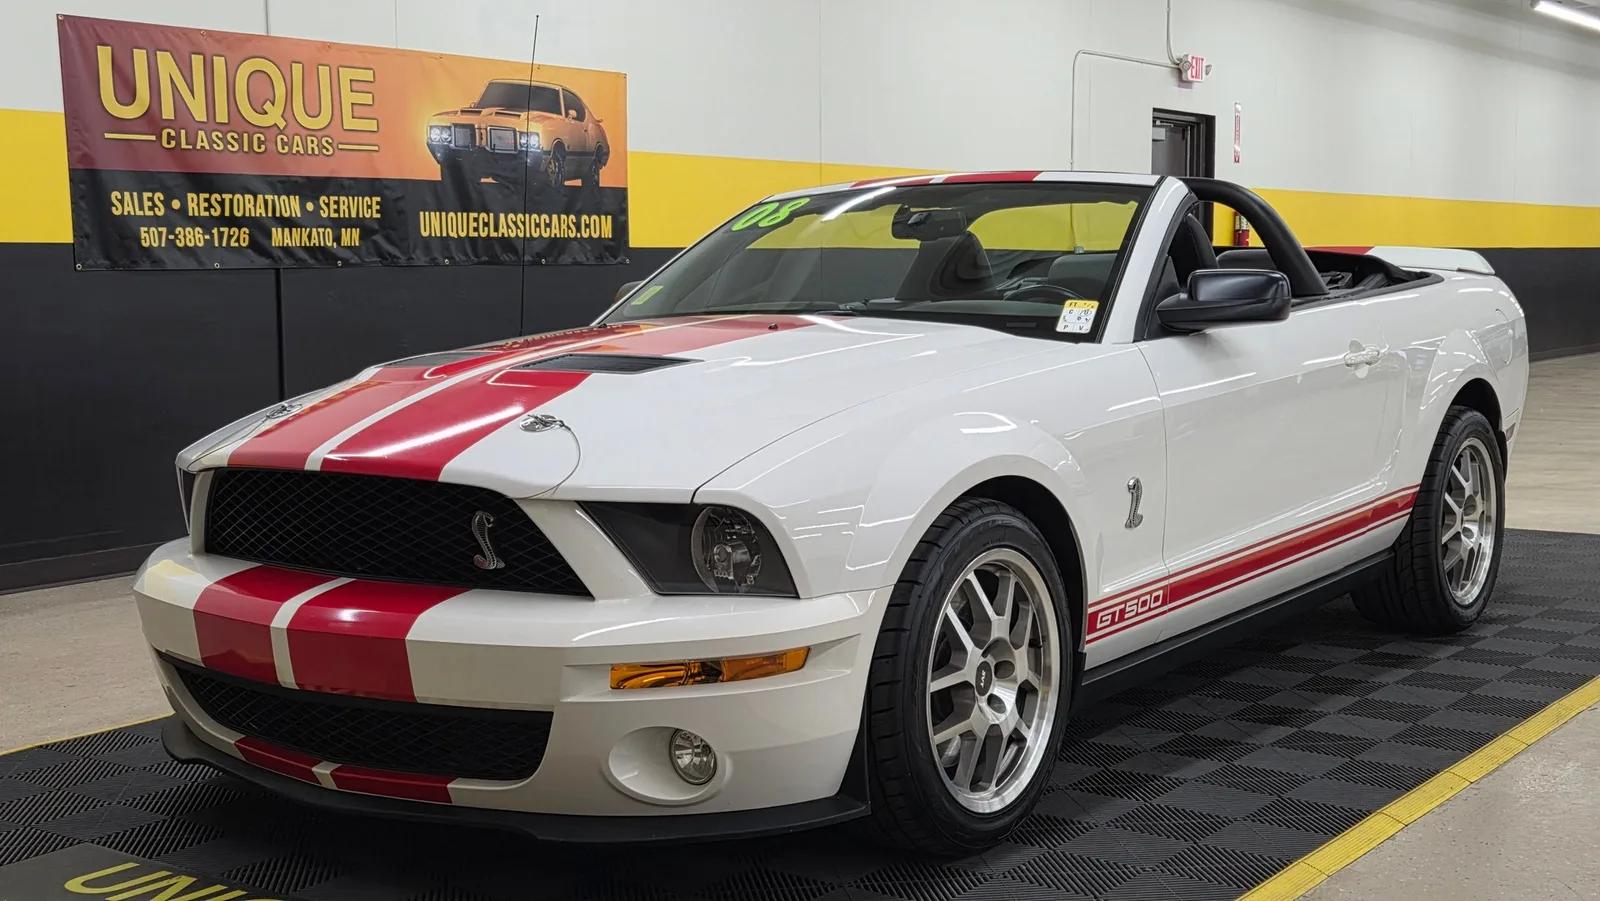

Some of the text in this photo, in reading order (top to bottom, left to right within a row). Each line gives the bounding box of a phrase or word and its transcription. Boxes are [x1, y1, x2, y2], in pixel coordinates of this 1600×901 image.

[97, 45, 378, 130] UNIQUE
[162, 128, 335, 156] CLASSIC CARS
[110, 191, 381, 219] SALES RESTORATION SERVICE
[731, 197, 811, 231] 08
[139, 227, 360, 249] 507-386-1726 MANKATO, MN
[420, 211, 612, 239] UNIQUECLASSICCARS.COM
[1096, 590, 1163, 629] GT500
